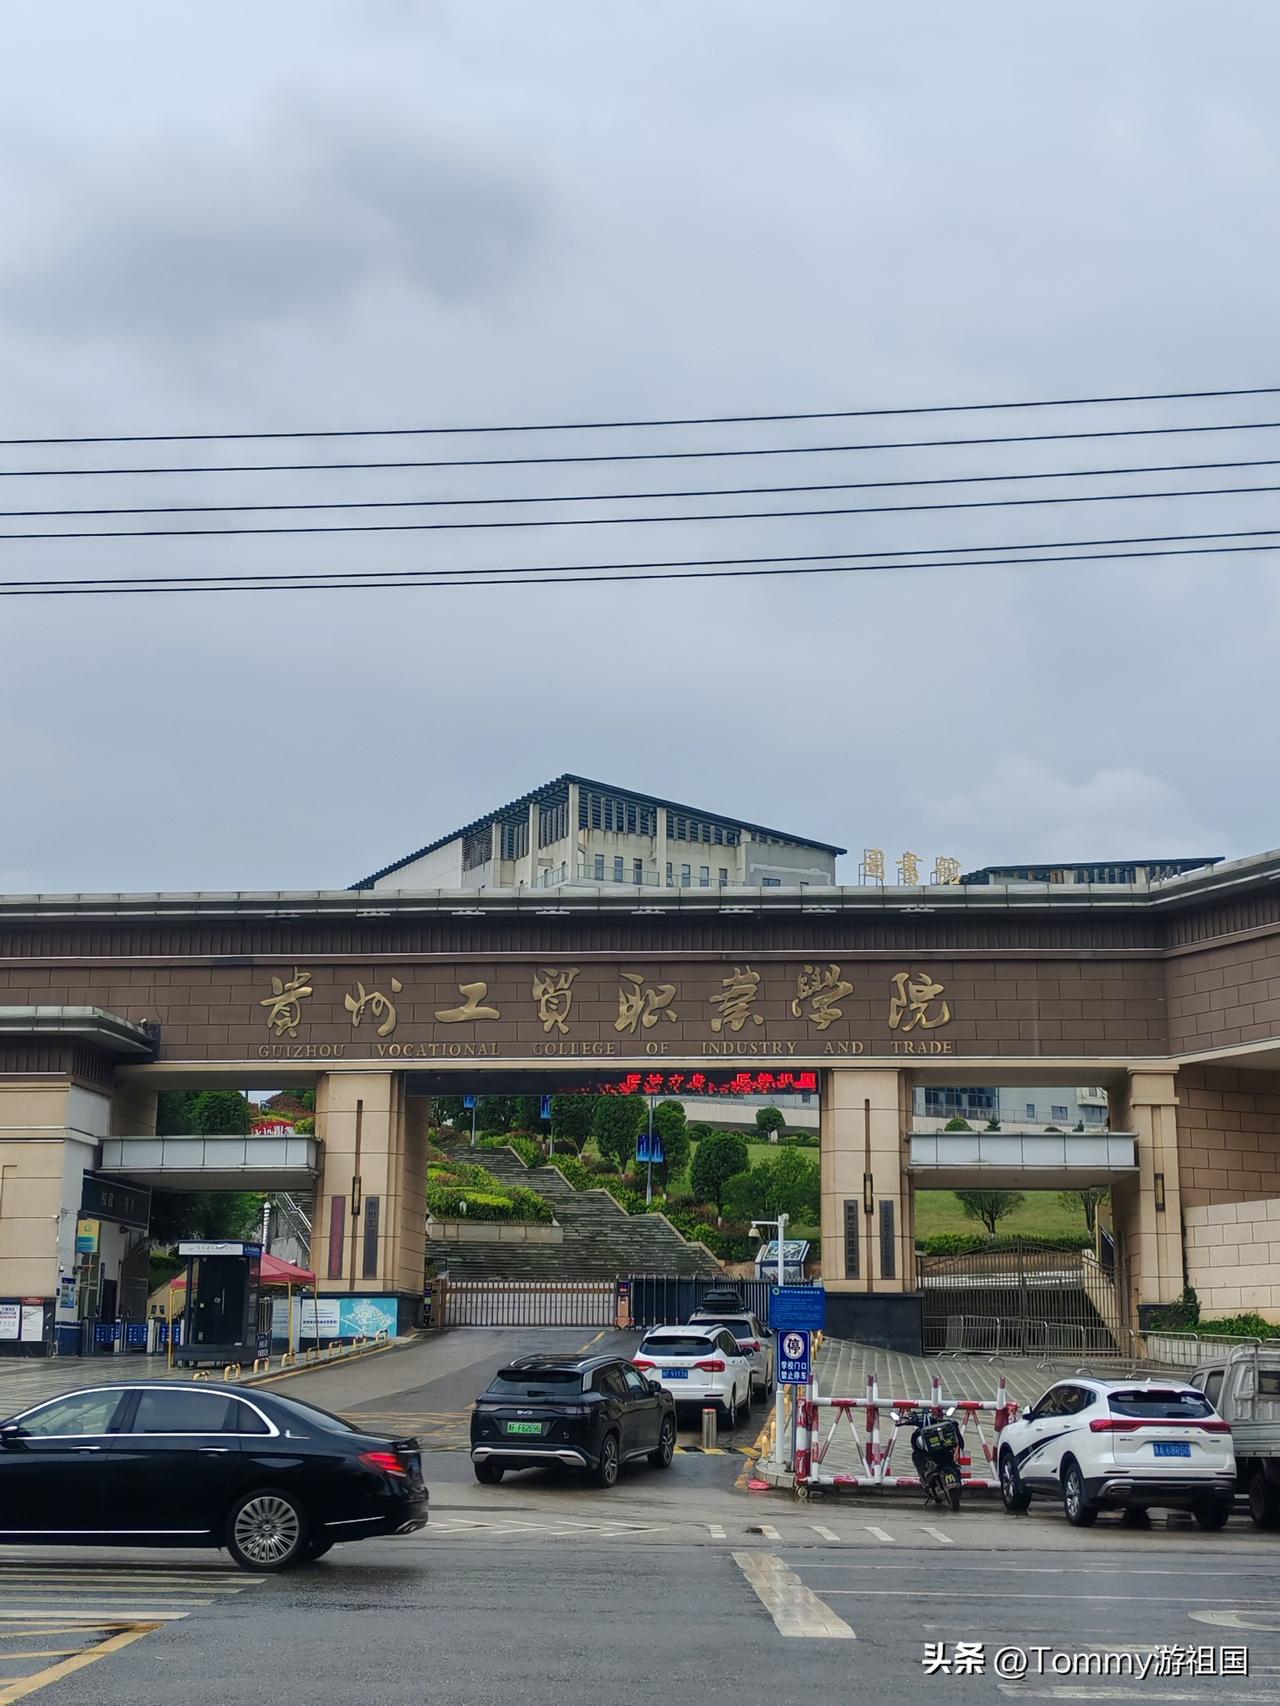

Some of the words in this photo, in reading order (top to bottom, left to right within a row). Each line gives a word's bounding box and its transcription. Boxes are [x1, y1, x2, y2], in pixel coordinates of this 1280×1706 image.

[257, 1043, 345, 1059] GUIZHOU
[376, 1042, 501, 1057] VOCATIONAL
[532, 1041, 617, 1056] COLLEGE
[645, 1041, 671, 1055] OF
[701, 1040, 799, 1055] INDUSTRY
[823, 1040, 865, 1055] AND
[891, 1040, 954, 1055] TRADE
[787, 1338, 801, 1355] 停
[781, 1361, 807, 1371] 学校门口
[781, 1371, 807, 1381] 禁止停车
